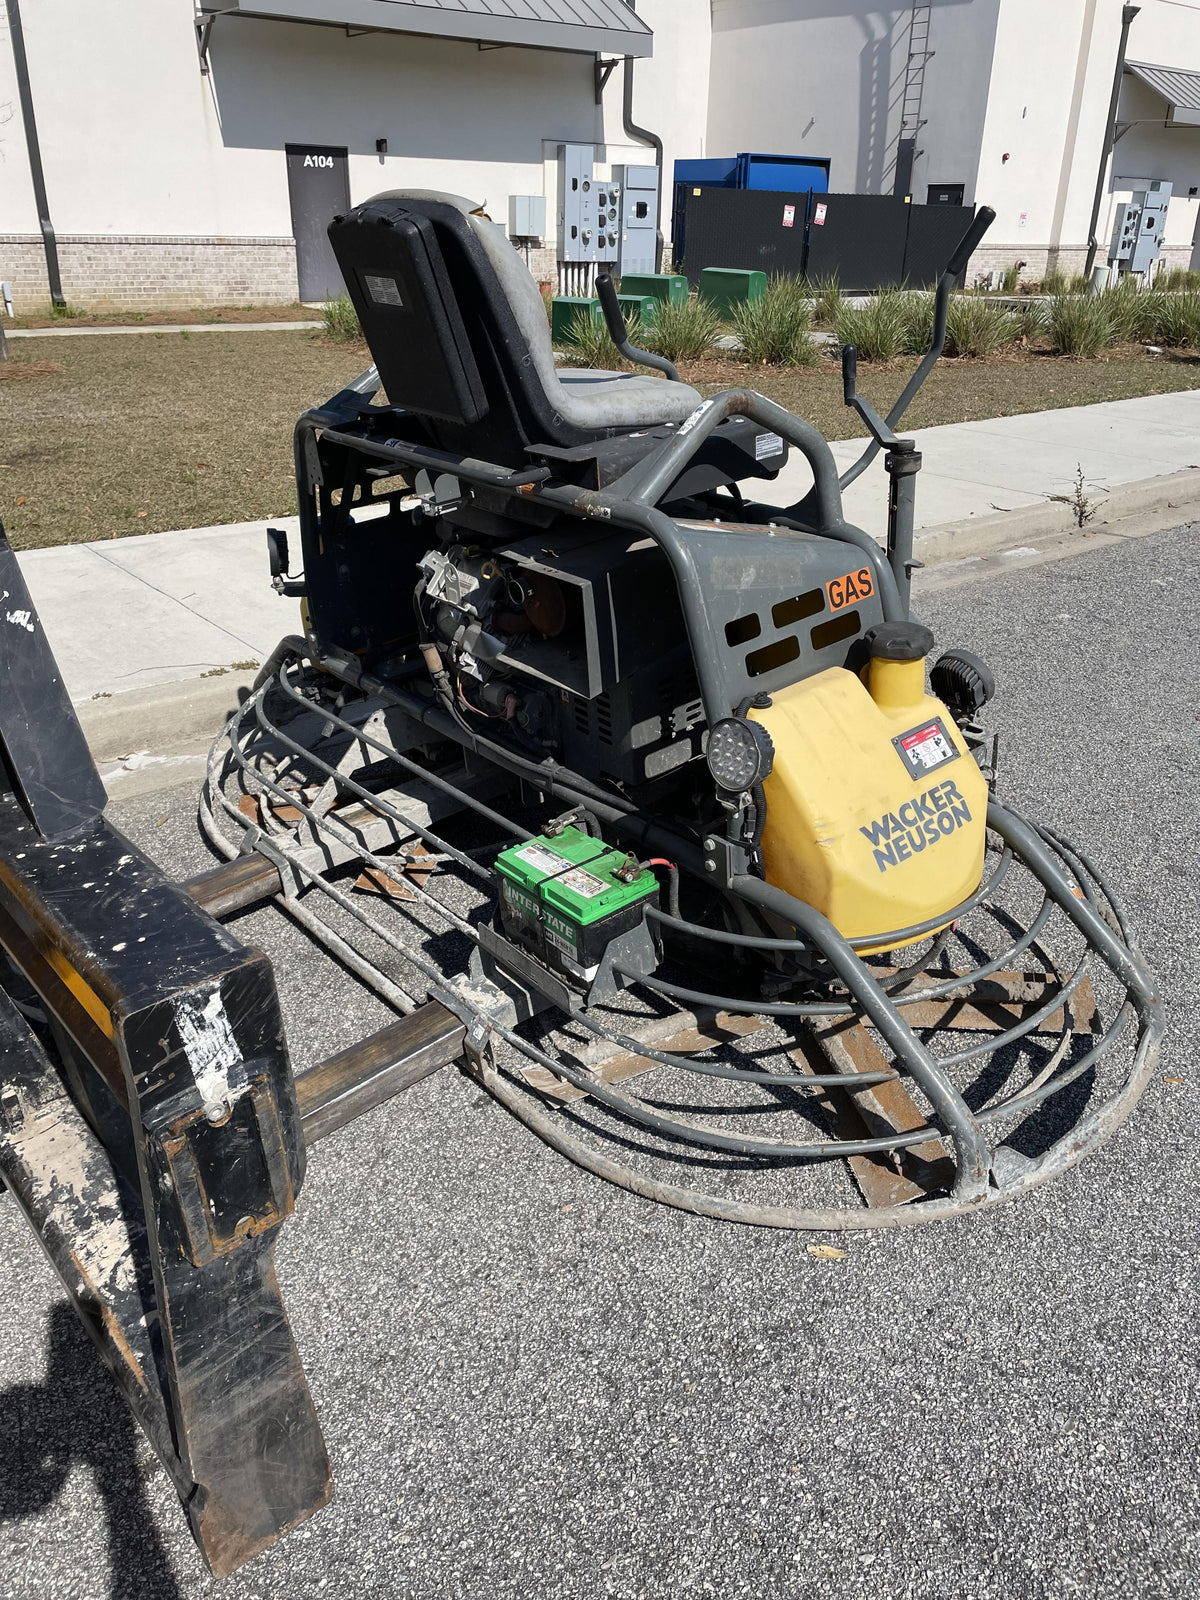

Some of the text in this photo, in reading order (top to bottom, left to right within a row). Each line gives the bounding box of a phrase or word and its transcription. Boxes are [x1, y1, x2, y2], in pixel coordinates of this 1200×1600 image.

[303, 154, 334, 168] A104
[829, 569, 872, 608] GAS
[859, 780, 963, 847] WACKER
[872, 799, 972, 872] NEUSON
